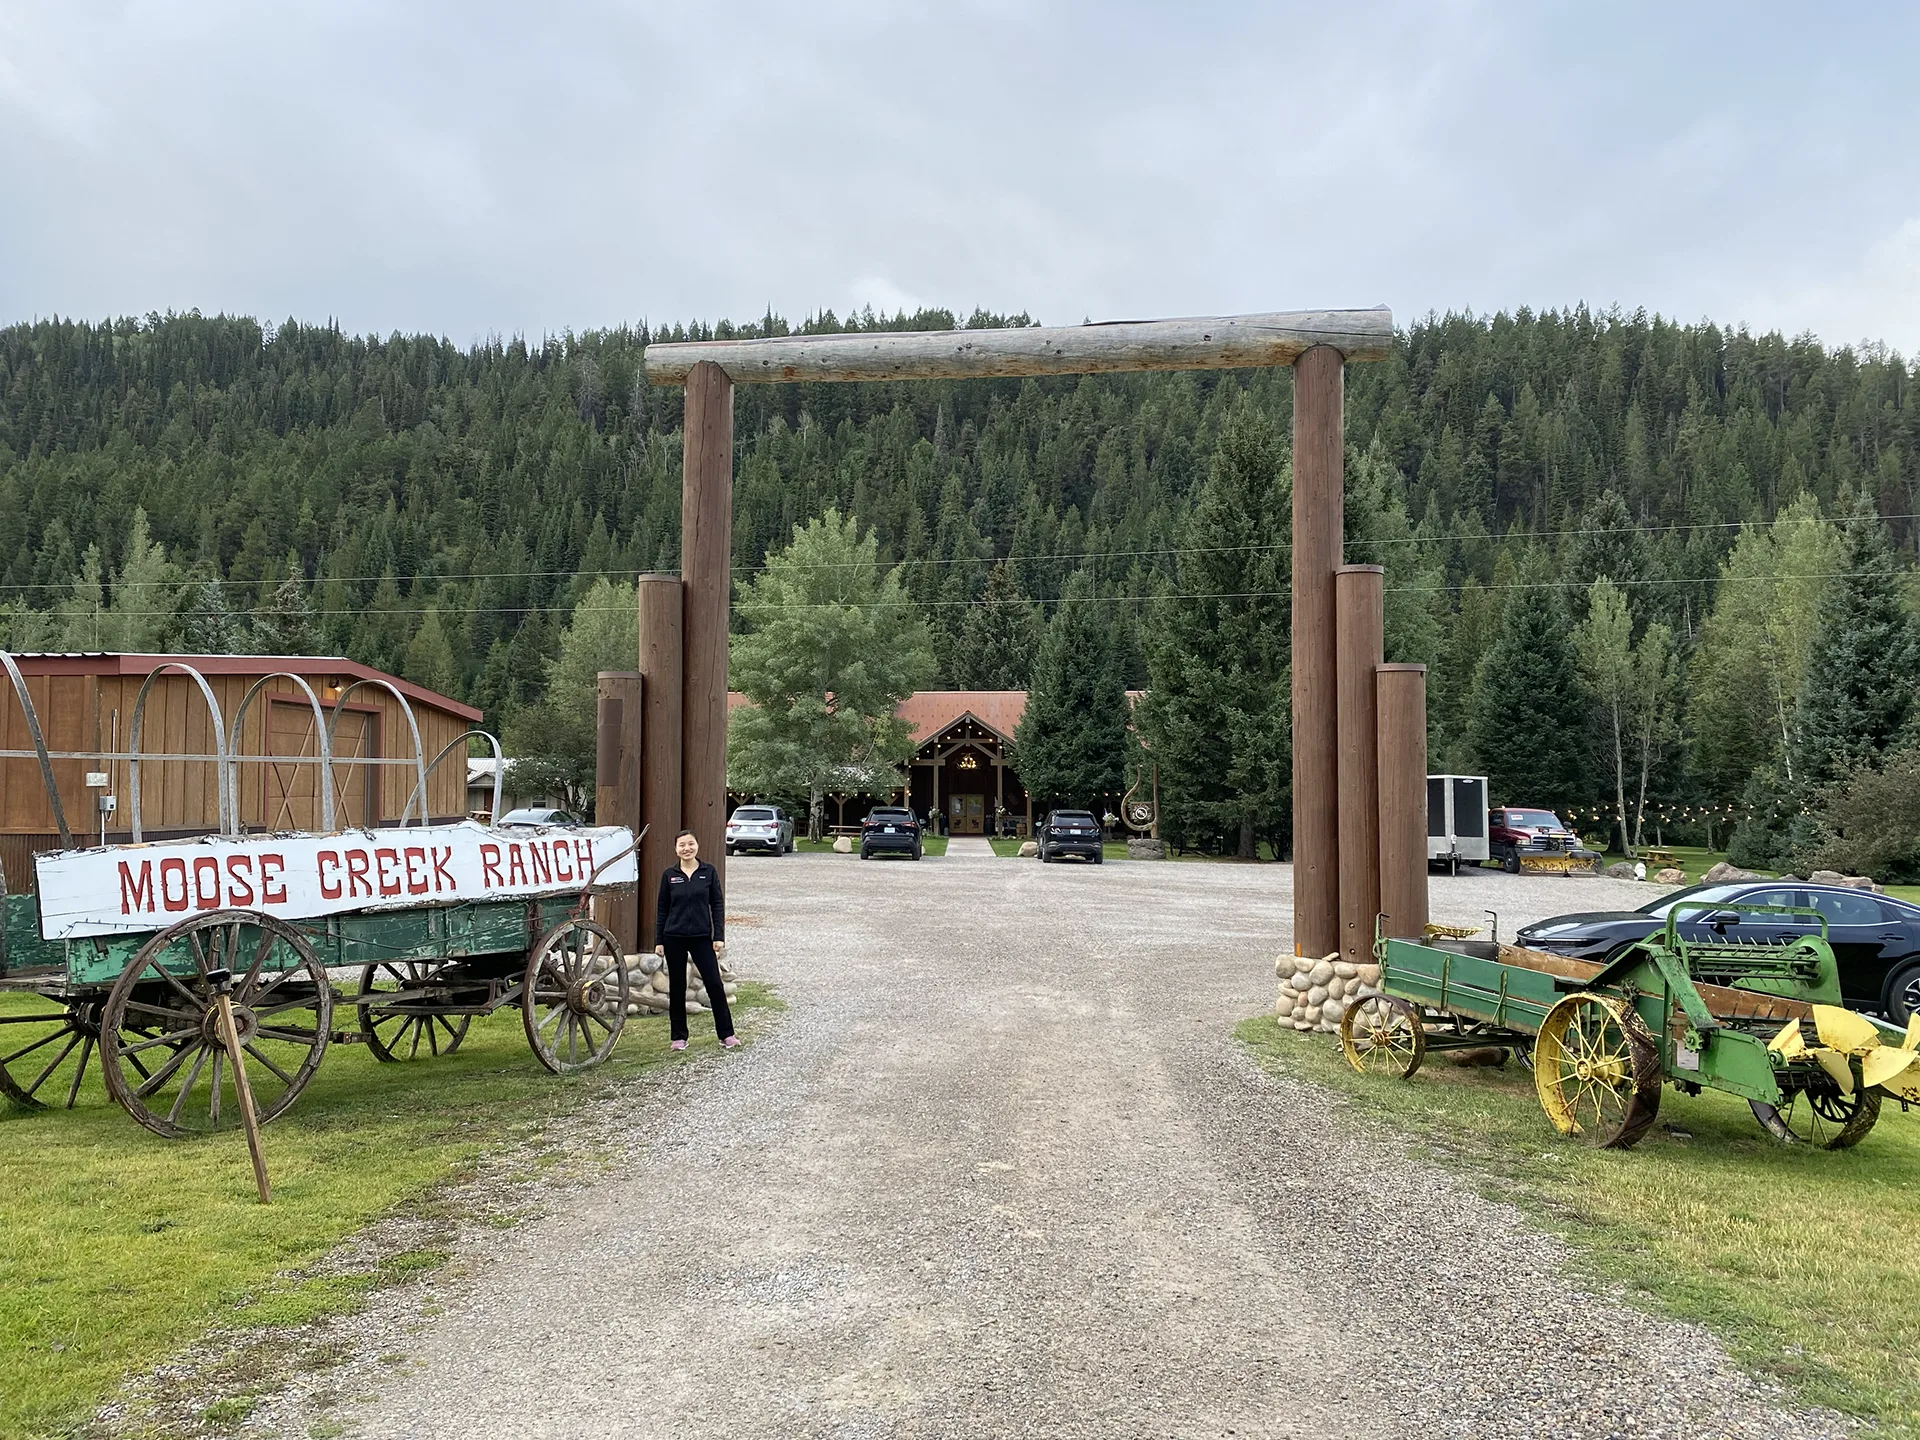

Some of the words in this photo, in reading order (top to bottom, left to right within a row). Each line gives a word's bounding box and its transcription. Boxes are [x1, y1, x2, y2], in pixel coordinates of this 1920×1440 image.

[118, 854, 287, 914] MOOSE
[317, 845, 456, 898] CREEK
[480, 839, 596, 888] RANCH
